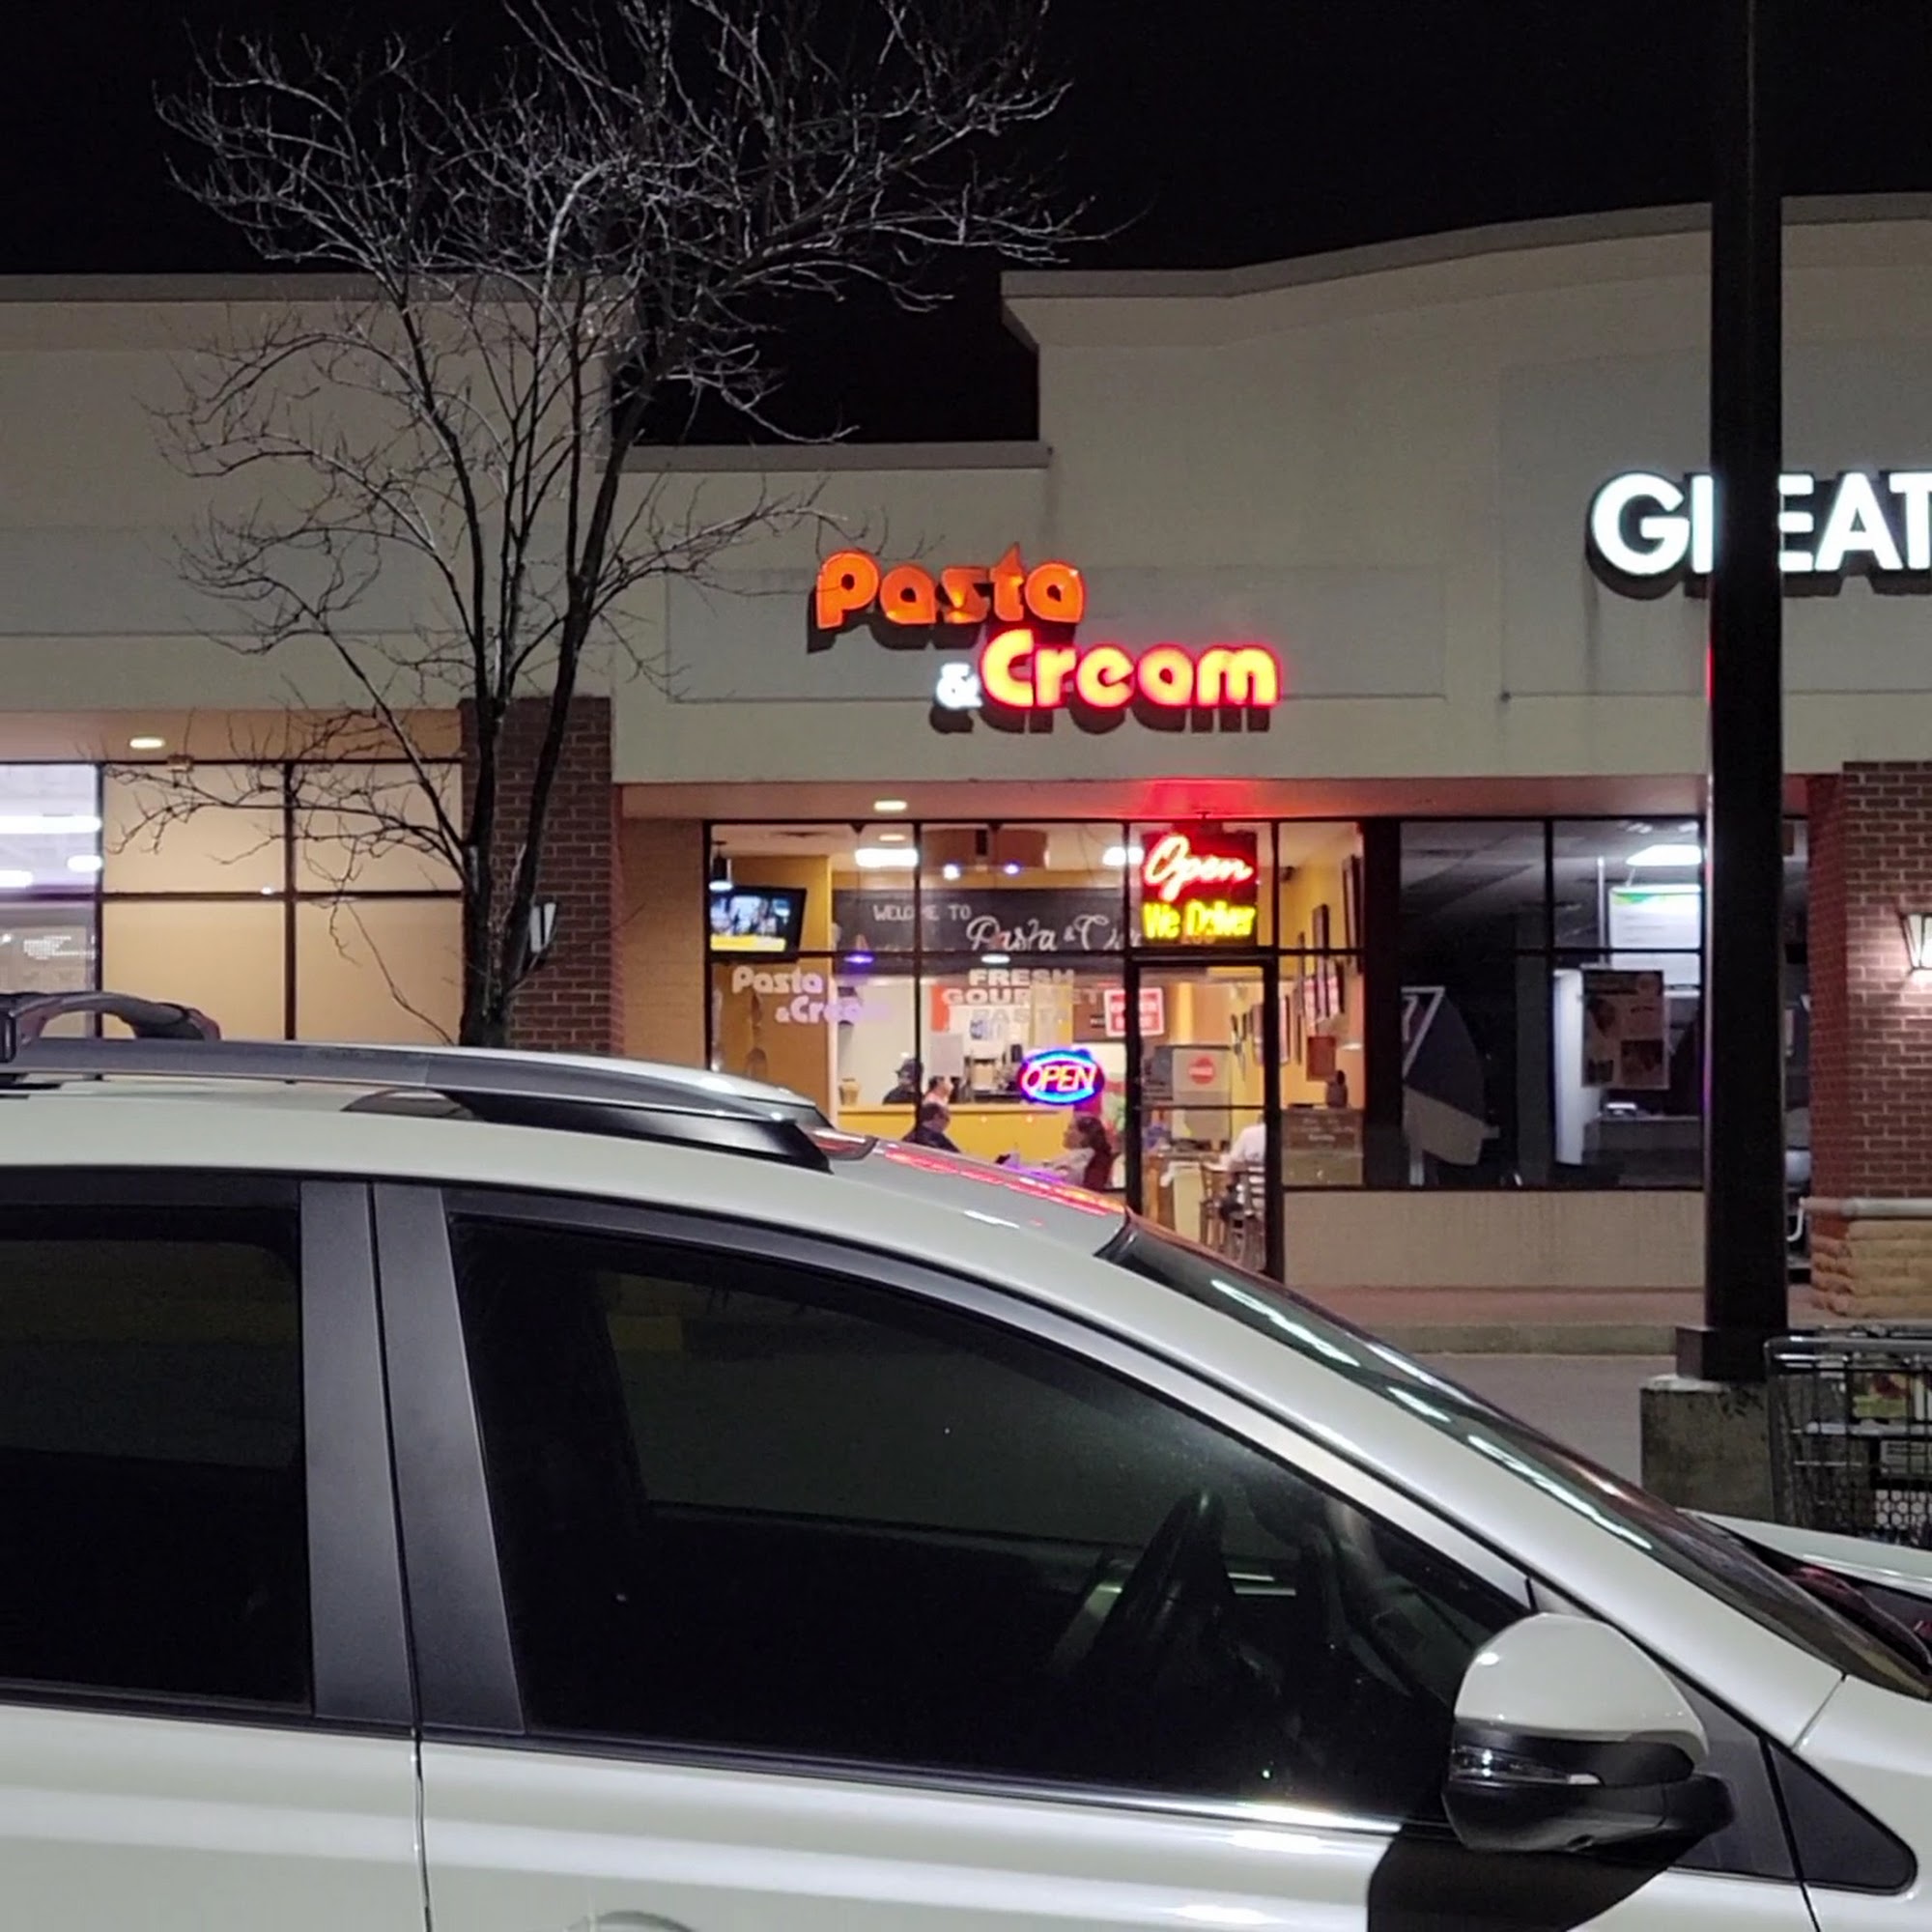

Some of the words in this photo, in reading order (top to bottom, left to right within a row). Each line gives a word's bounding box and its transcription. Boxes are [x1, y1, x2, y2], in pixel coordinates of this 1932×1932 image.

[816, 542, 1086, 630] Pasta
[935, 663, 982, 709] &
[980, 627, 1280, 708] Cream
[1144, 834, 1254, 902] Open
[873, 904, 940, 922] WELCE
[948, 903, 972, 921] TO
[1143, 902, 1180, 938] We
[732, 966, 822, 994] Pasta
[969, 968, 1075, 986] FRESH
[790, 995, 890, 1024] Crea
[942, 987, 1098, 1005] GOURET
[1021, 1065, 1097, 1094] OPEN
